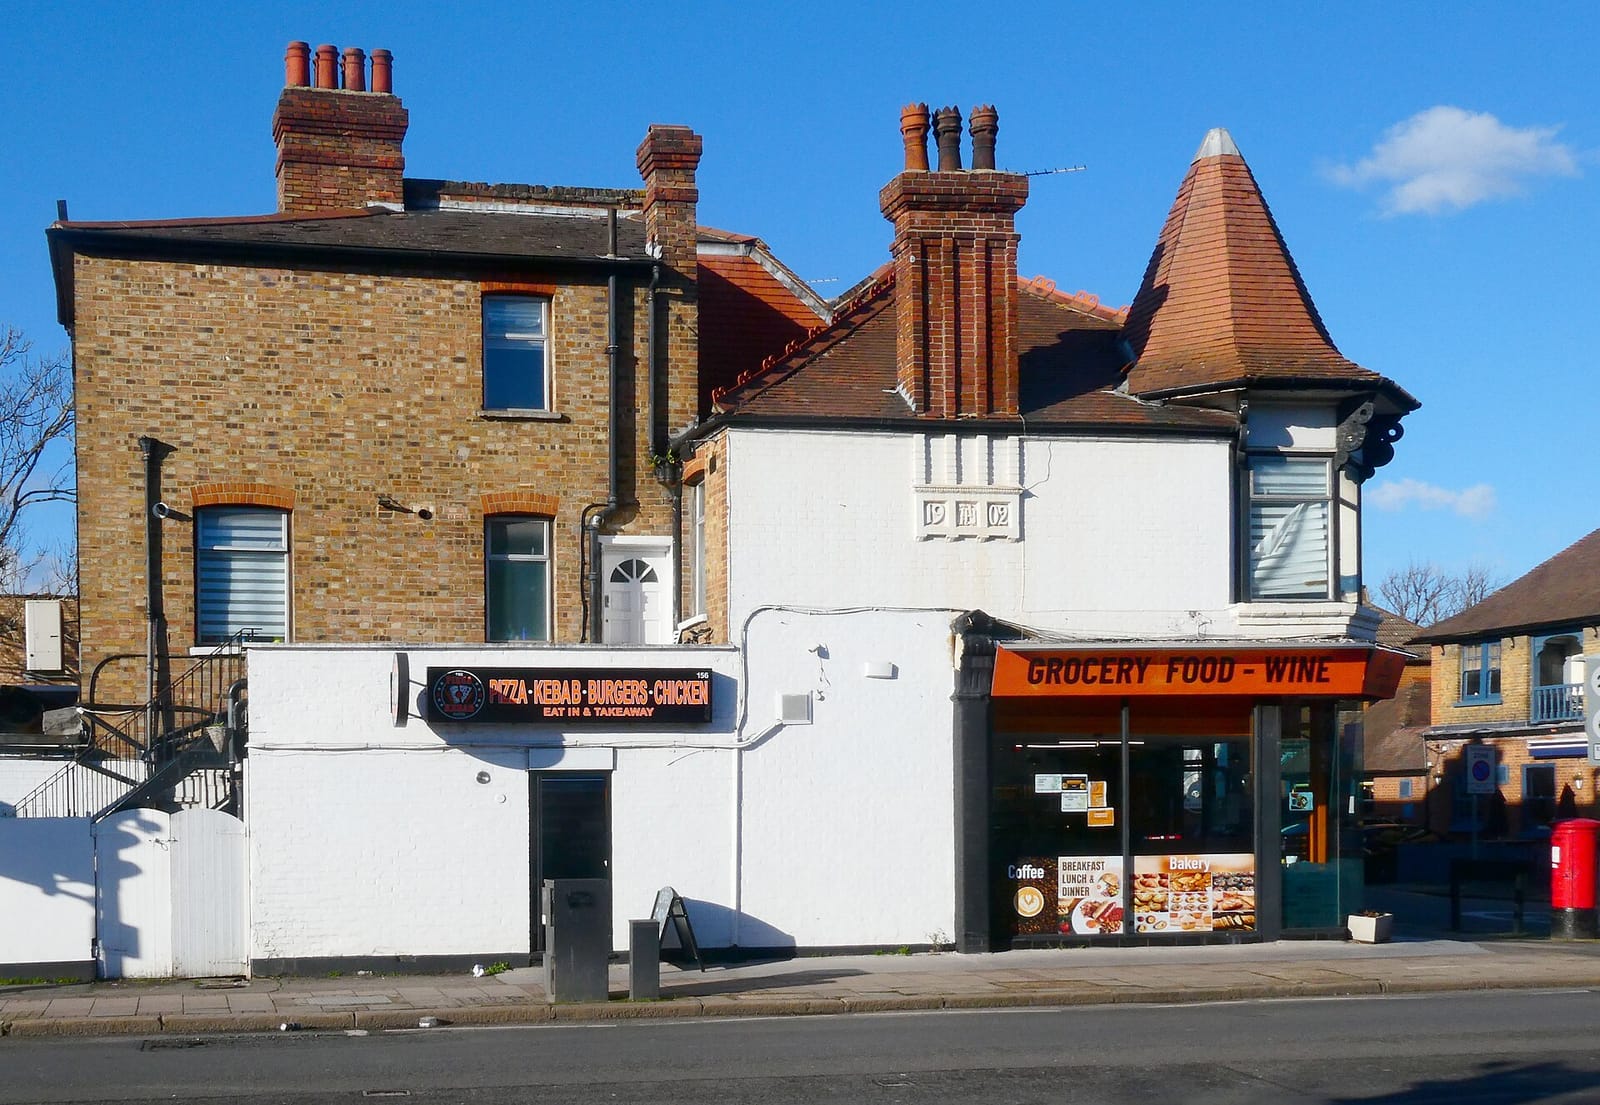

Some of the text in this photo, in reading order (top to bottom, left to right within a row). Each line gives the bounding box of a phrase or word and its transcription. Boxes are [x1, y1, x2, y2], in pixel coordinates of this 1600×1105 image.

[1028, 656, 1152, 685] GROCERY
[1166, 656, 1236, 684] FOOD
[1265, 656, 1332, 683] WINE
[489, 679, 708, 704] PIZZA KEBAB BURGERS CHICKEN
[543, 707, 654, 717] EAT IN & TAKEAWAY
[1062, 861, 1105, 871] BREAKFAST
[1169, 856, 1210, 873] Bakery
[1008, 864, 1045, 879] Coffee
[1062, 874, 1095, 884] LUNCH &
[1062, 887, 1090, 897] DINNER
